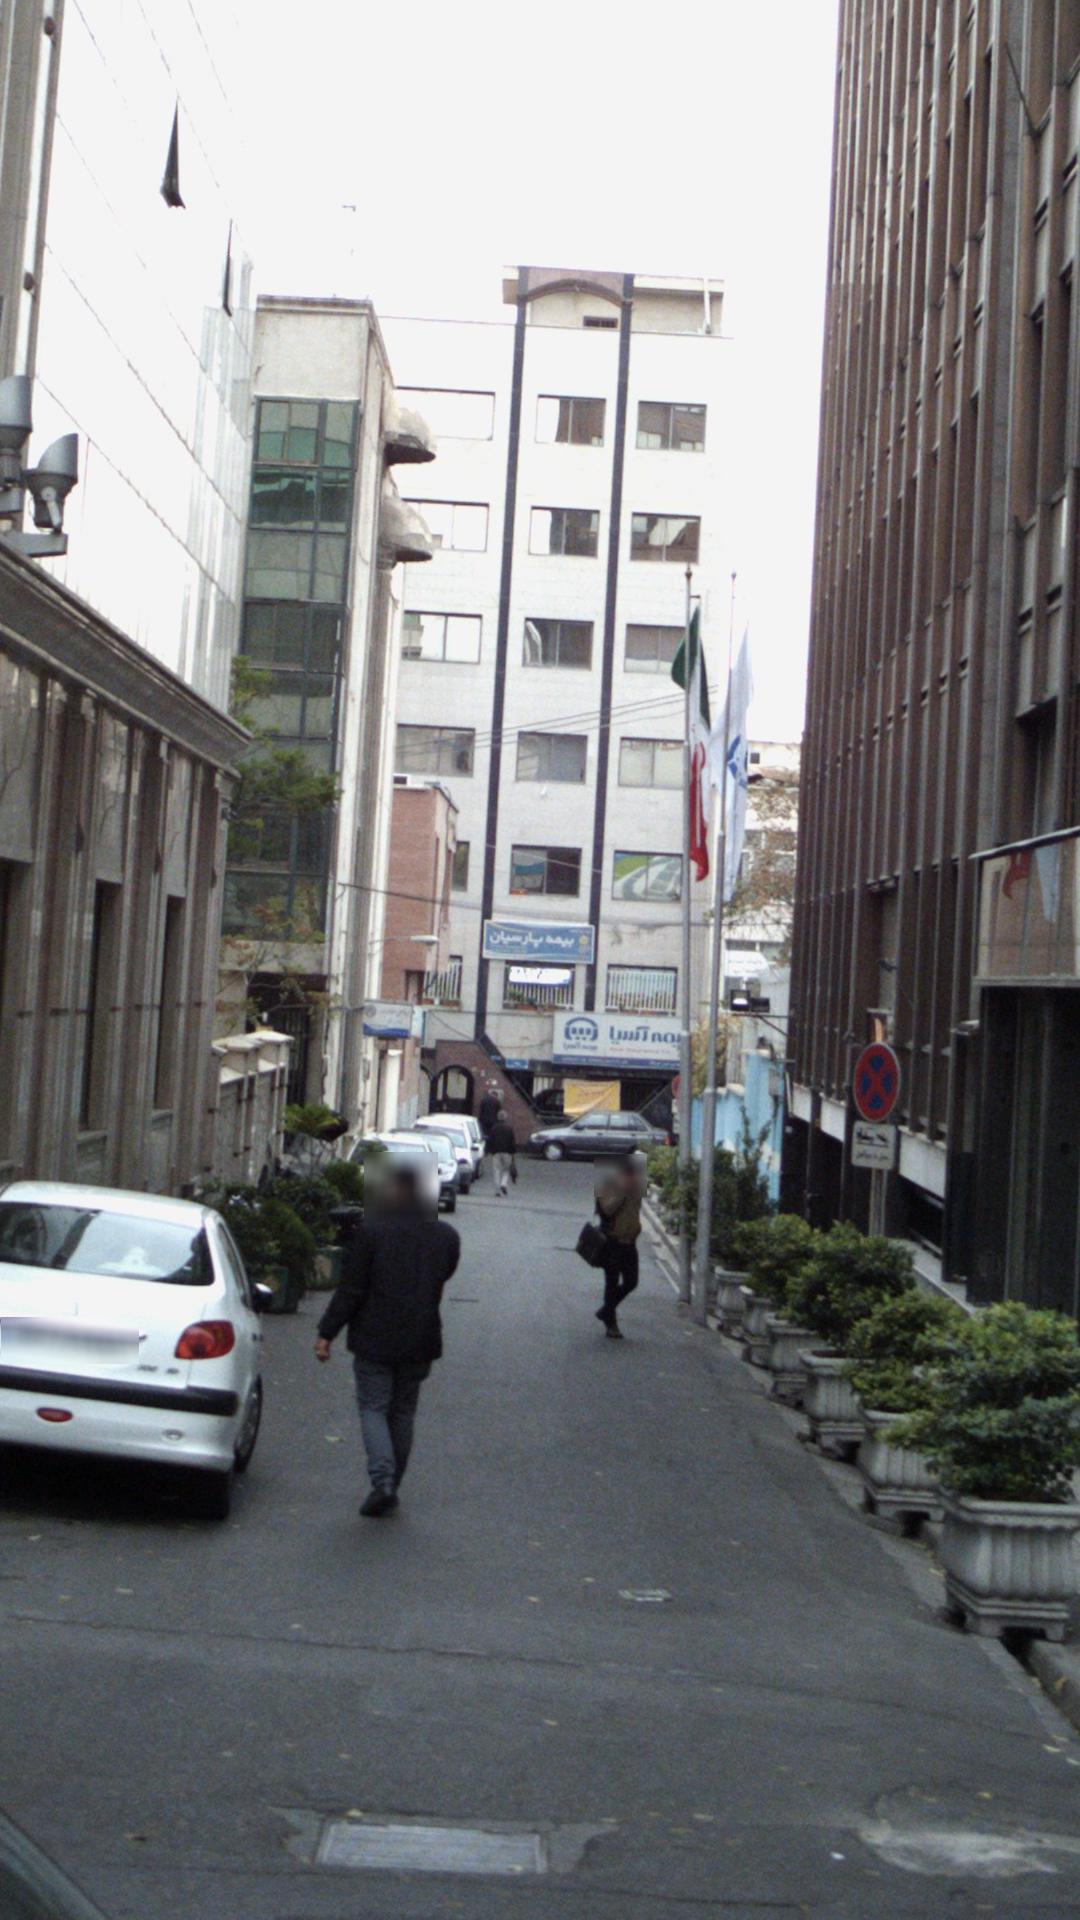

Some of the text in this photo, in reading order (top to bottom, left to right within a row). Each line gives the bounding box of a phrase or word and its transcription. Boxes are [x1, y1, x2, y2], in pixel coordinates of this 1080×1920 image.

[489, 930, 574, 949] بیمه پارسیان
[608, 1025, 650, 1045] آسیا
